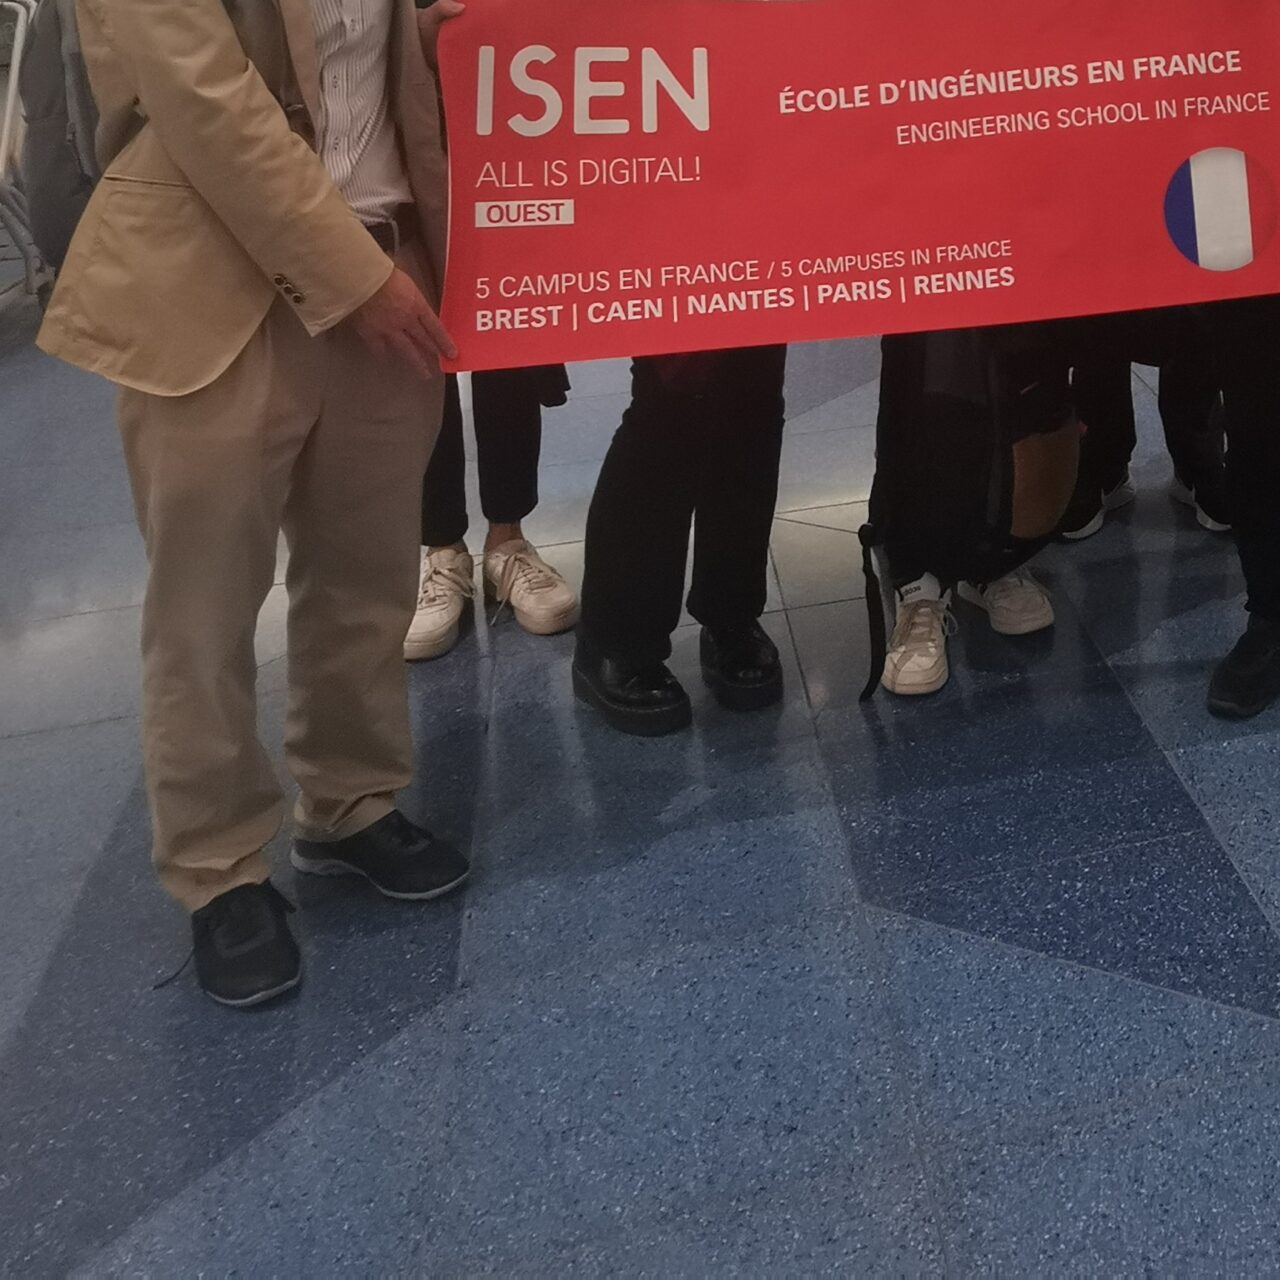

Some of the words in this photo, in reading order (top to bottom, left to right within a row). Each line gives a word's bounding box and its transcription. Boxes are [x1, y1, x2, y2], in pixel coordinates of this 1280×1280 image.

[475, 44, 710, 138] ISEN
[779, 85, 871, 114] ÉCOLE
[879, 64, 1079, 105] D'INGÉNIEURS
[1087, 59, 1125, 85] EN
[1133, 50, 1242, 80] FRANCE
[896, 110, 1050, 146] ENGINEERING
[1056, 102, 1150, 129] SCHOOL
[1155, 99, 1177, 120] IN
[1183, 91, 1271, 118] FRANCE
[475, 161, 534, 188] ALL
[543, 159, 568, 187] IS
[579, 155, 702, 186] DIGITAL!
[486, 202, 565, 224] OUEST
[475, 277, 490, 300] 5
[499, 270, 610, 298] CAMPUS
[618, 268, 652, 291] EN
[660, 260, 760, 287] FRANCE
[780, 260, 793, 278] 5
[798, 250, 906, 277] CAMPUSES
[911, 248, 931, 266] IN
[936, 239, 1013, 264] FRANCE
[475, 304, 564, 332] BREST
[587, 297, 663, 324] CAEN
[687, 286, 796, 316] NANTES
[816, 278, 893, 305] PARIS
[913, 266, 1016, 297] RENNES
